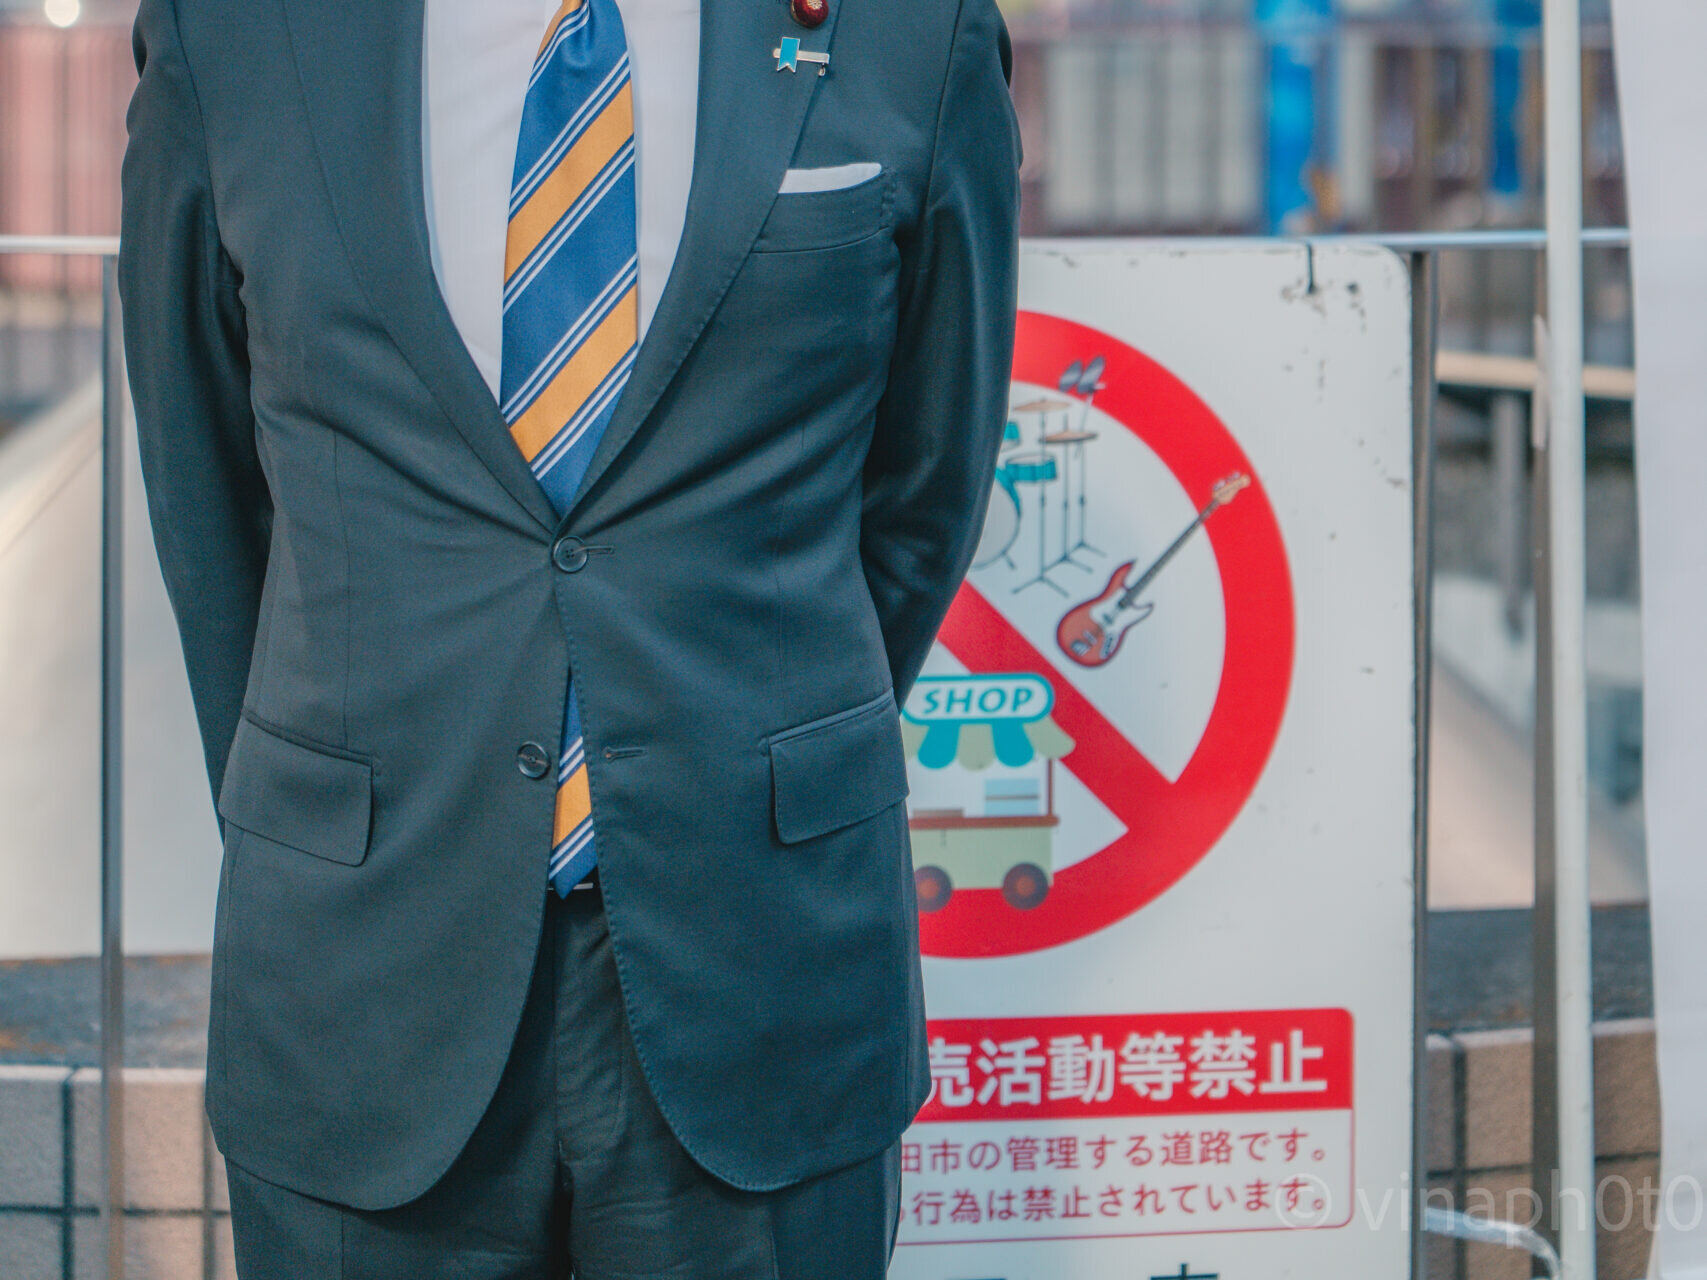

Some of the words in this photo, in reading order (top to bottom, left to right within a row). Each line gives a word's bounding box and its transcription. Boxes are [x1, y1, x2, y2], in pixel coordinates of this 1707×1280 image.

[923, 686, 1033, 714] SHOP
[922, 1029, 1328, 1107] 売活動等禁止
[901, 1128, 1326, 1175] 田市の管理する道路です。
[899, 1178, 1327, 1226] 行為は禁止されています。
